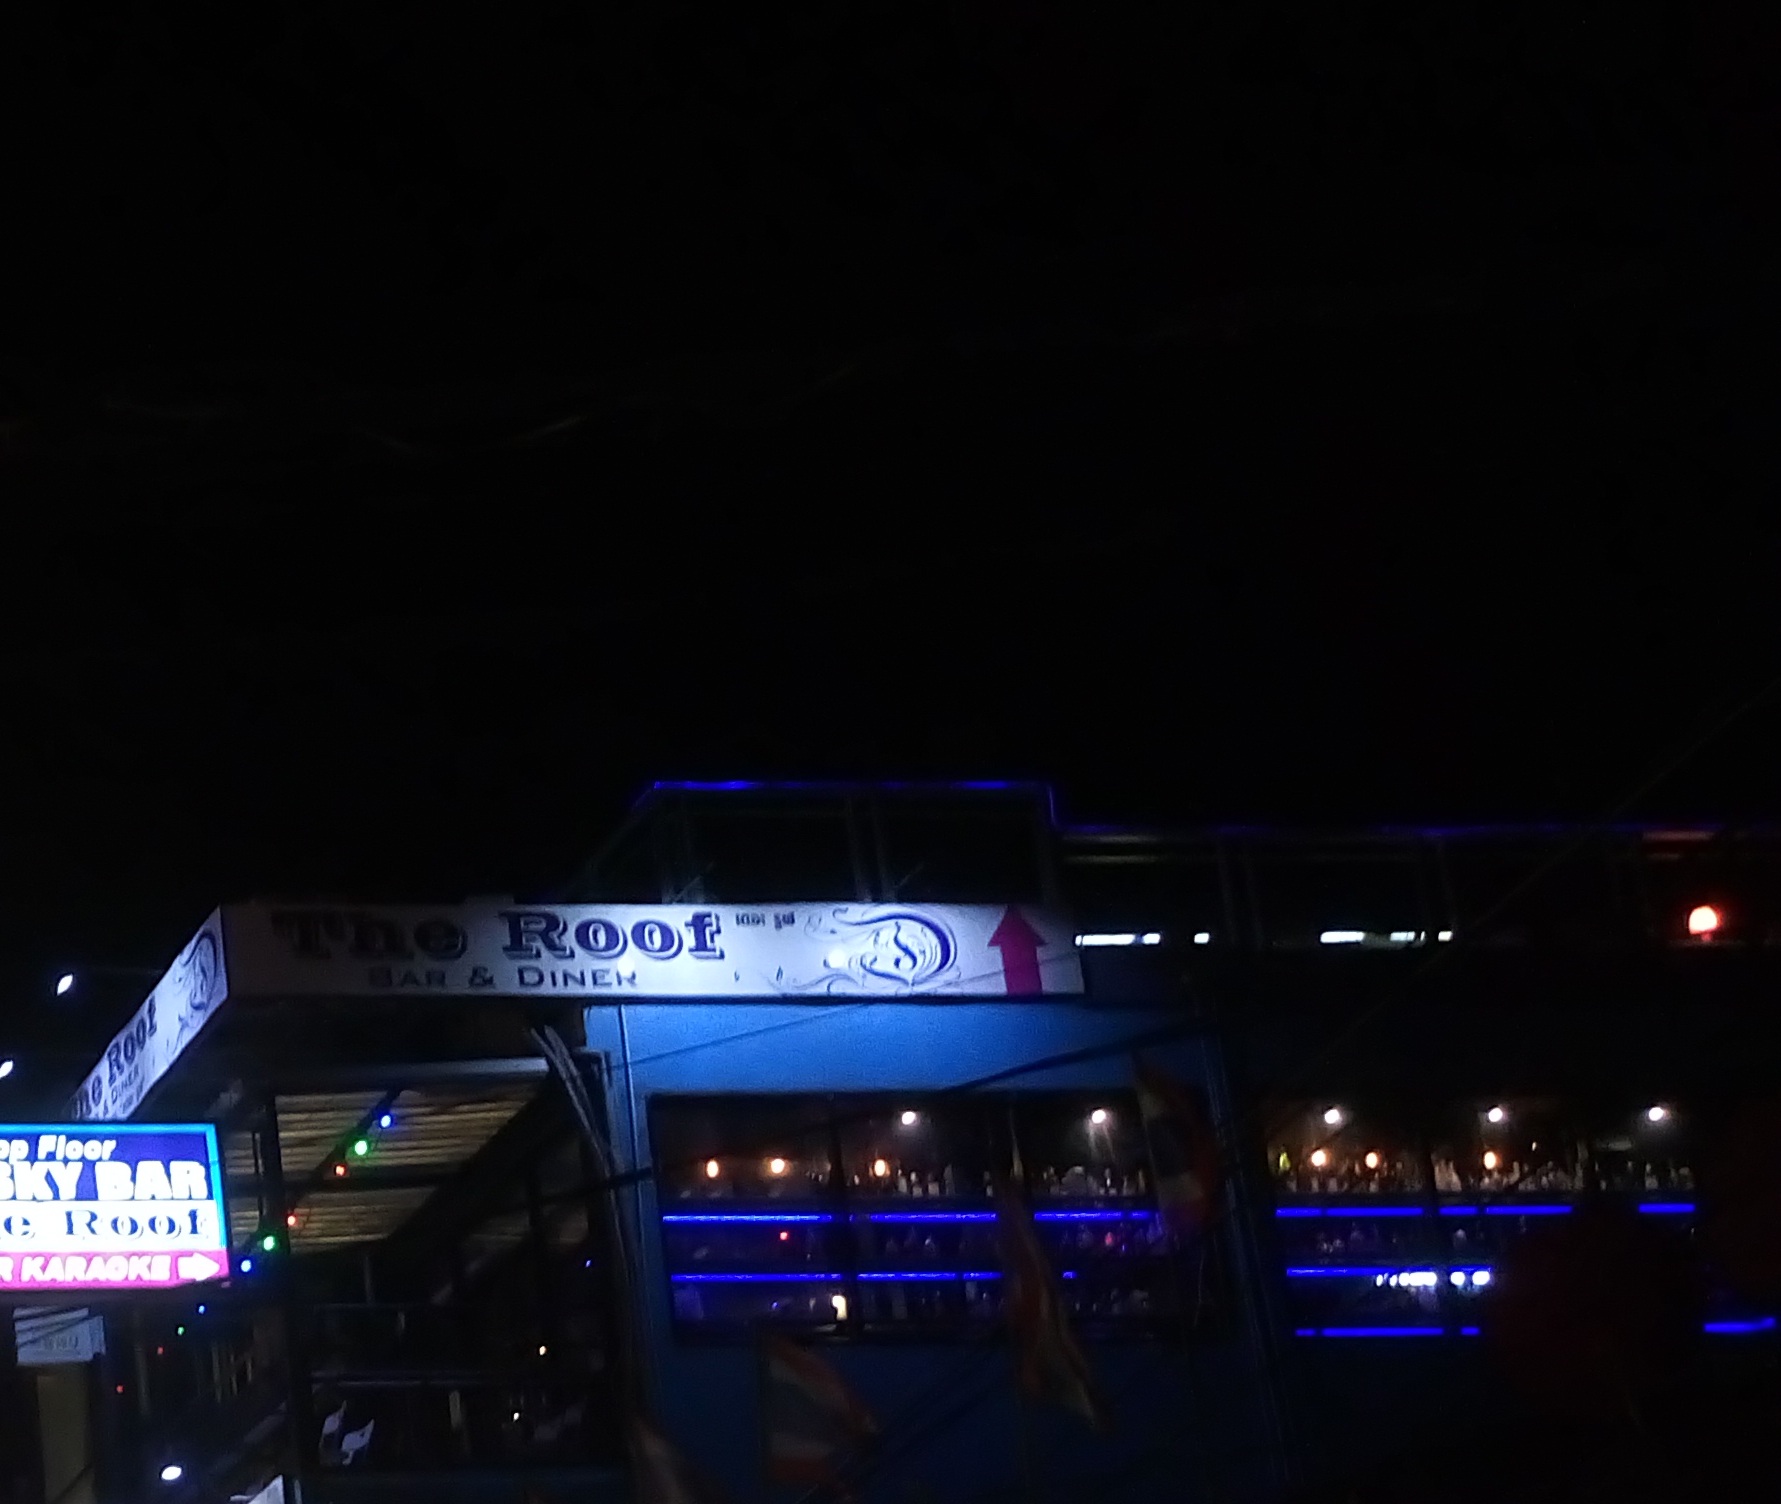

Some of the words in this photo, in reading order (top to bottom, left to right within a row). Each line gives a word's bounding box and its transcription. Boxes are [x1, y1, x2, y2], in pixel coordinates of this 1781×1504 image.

[499, 910, 726, 961] Roof
[37, 1135, 118, 1162] Floor
[95, 1160, 209, 1202] BAR
[65, 1208, 211, 1241] Roof
[20, 1255, 173, 1283] KARAOKE
